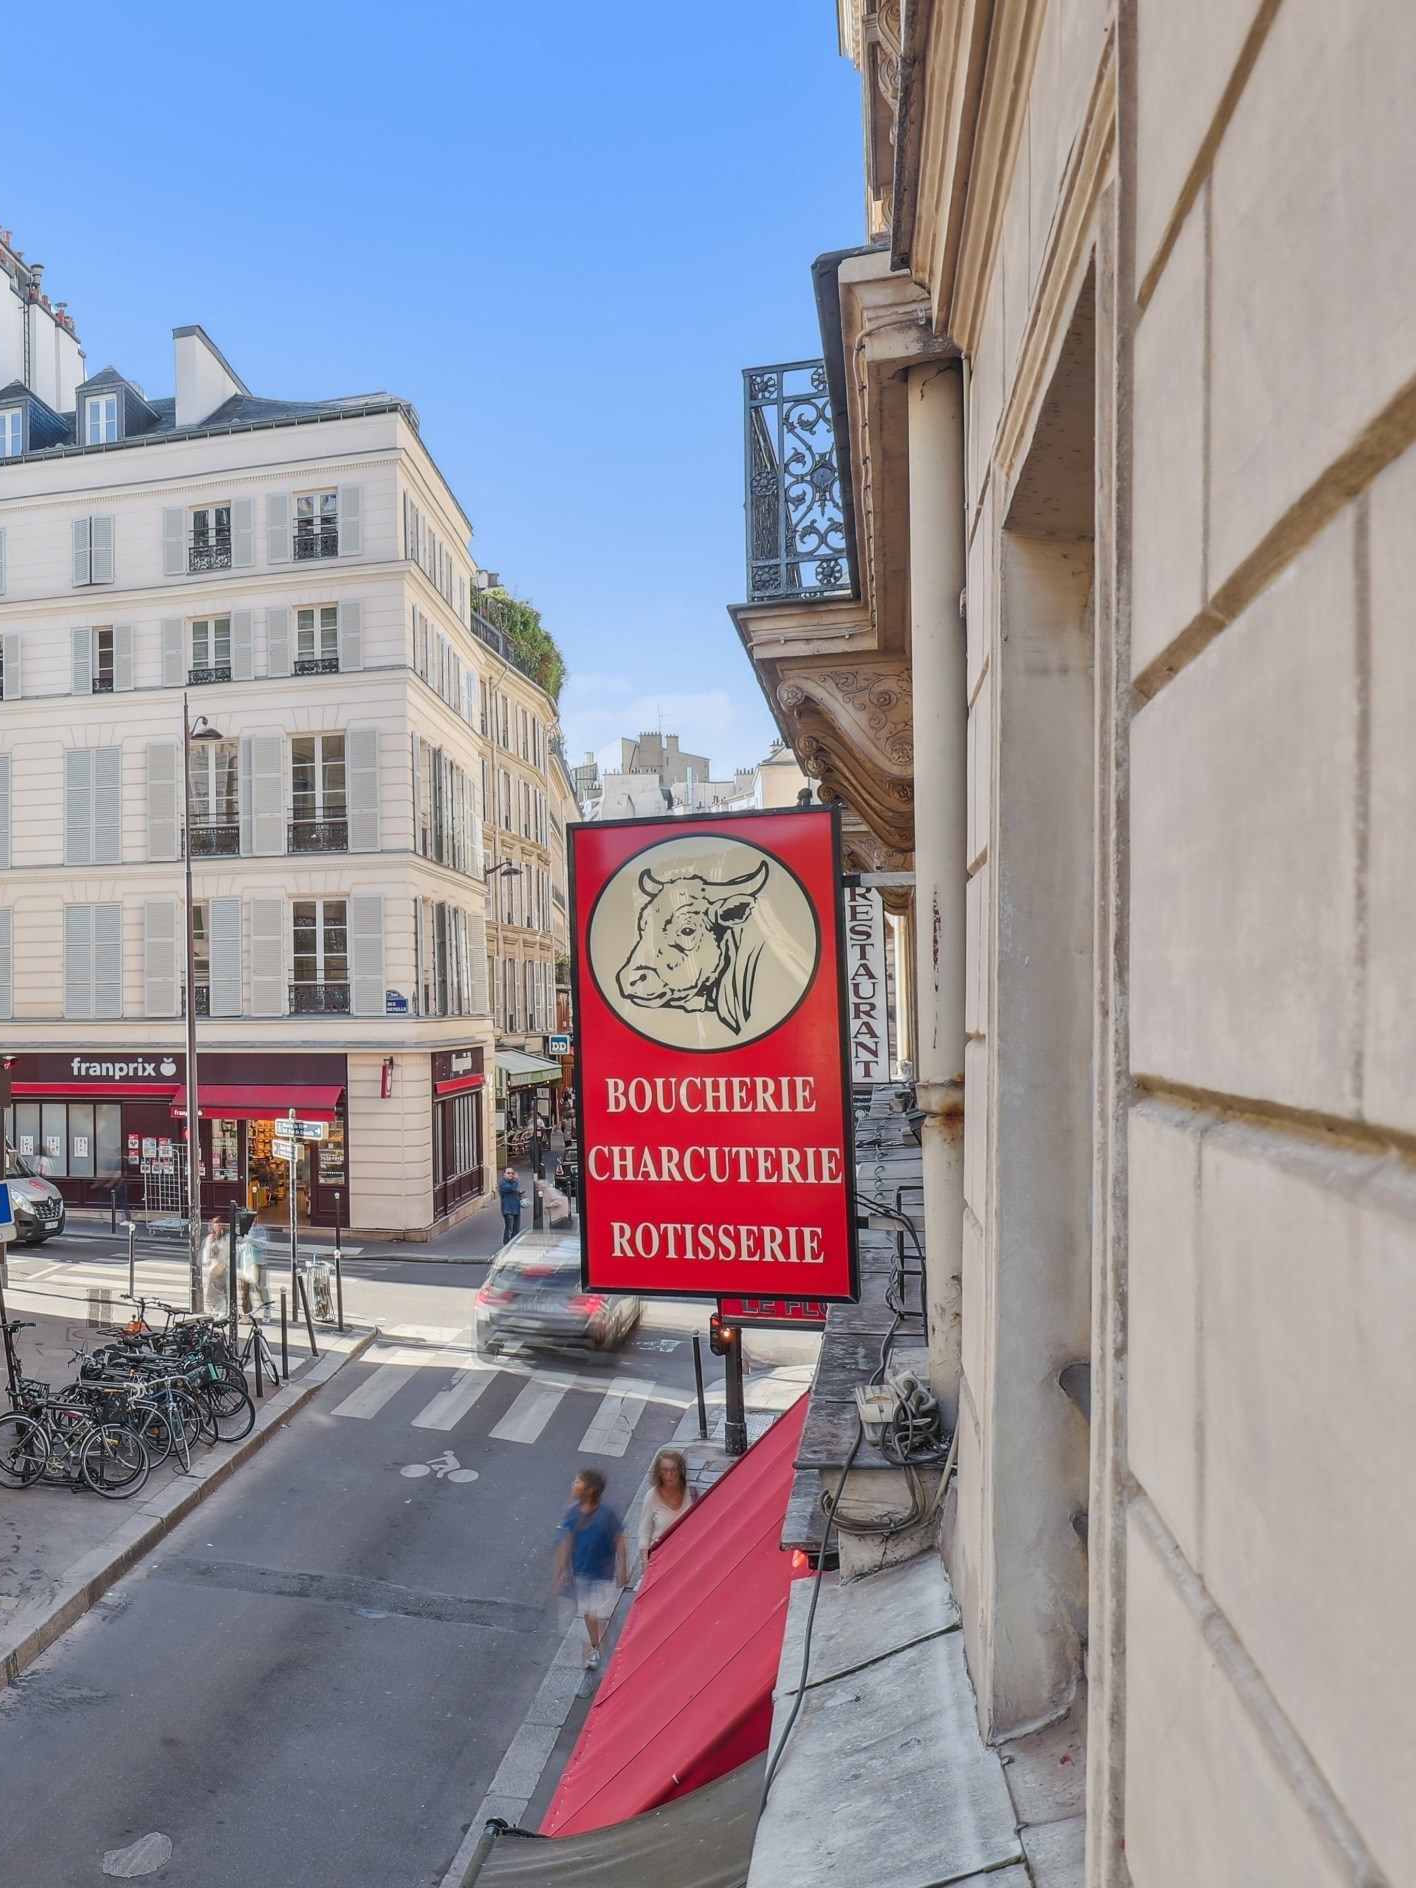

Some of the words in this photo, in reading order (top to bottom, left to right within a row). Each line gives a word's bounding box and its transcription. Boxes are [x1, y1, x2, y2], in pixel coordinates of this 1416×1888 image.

[849, 887, 879, 1079] RESTAURANT
[552, 1042, 567, 1051] DD
[71, 1057, 157, 1080] franprix
[605, 1076, 817, 1113] BOUCHERIE
[587, 1145, 843, 1184] CHARCUTERIE
[610, 1222, 825, 1263] ROTISSERIE
[742, 1299, 775, 1314] LE
